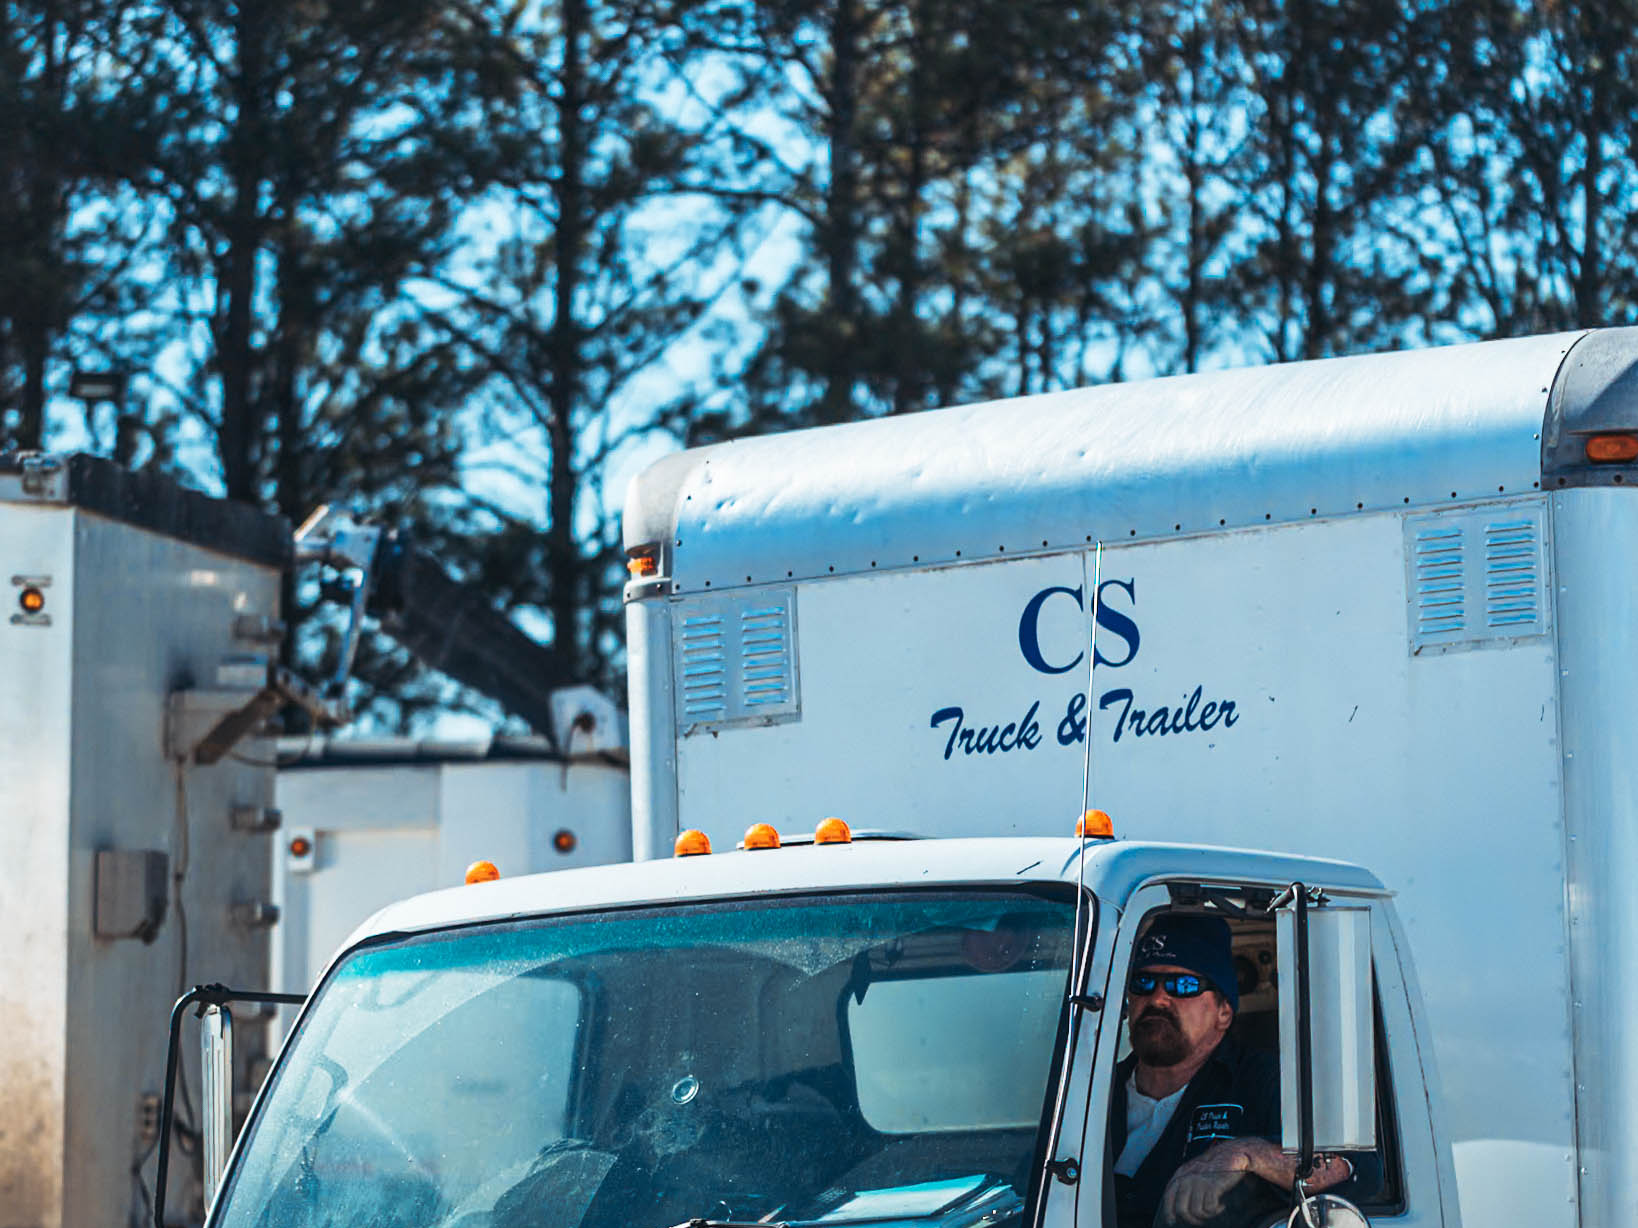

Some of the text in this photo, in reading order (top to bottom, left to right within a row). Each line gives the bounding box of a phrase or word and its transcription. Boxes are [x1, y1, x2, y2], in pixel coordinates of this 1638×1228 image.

[1018, 576, 1140, 674] CS
[930, 685, 1240, 760] Truck & Trailer
